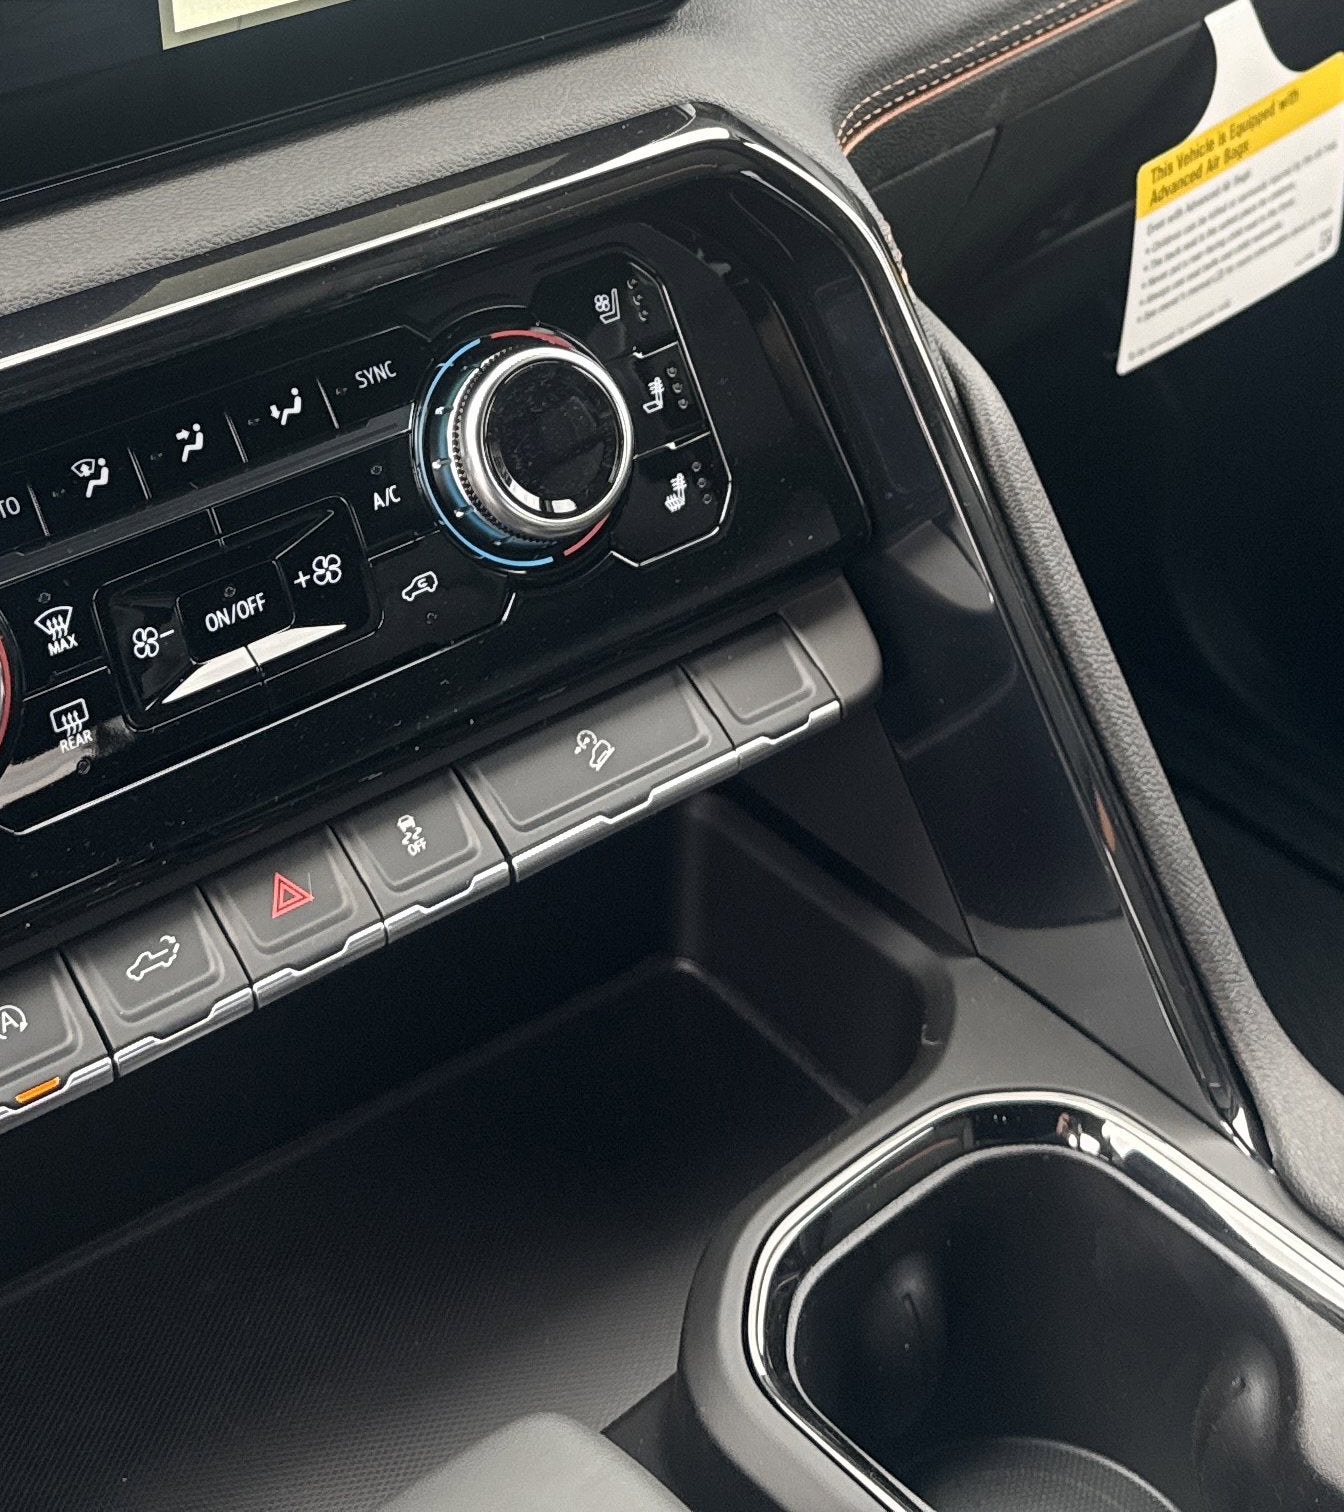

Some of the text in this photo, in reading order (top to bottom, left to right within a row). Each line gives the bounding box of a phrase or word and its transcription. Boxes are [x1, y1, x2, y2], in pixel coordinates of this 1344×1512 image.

[1151, 88, 1301, 185] This Vehicle is Equipped with
[1149, 140, 1251, 207] Advanced Air Bags
[355, 359, 397, 391] SYNC
[373, 483, 402, 512] A/C
[205, 592, 267, 634] ON/OFF
[47, 633, 79, 657] MAX
[59, 730, 94, 753] REAR
[408, 836, 427, 856] OFF
